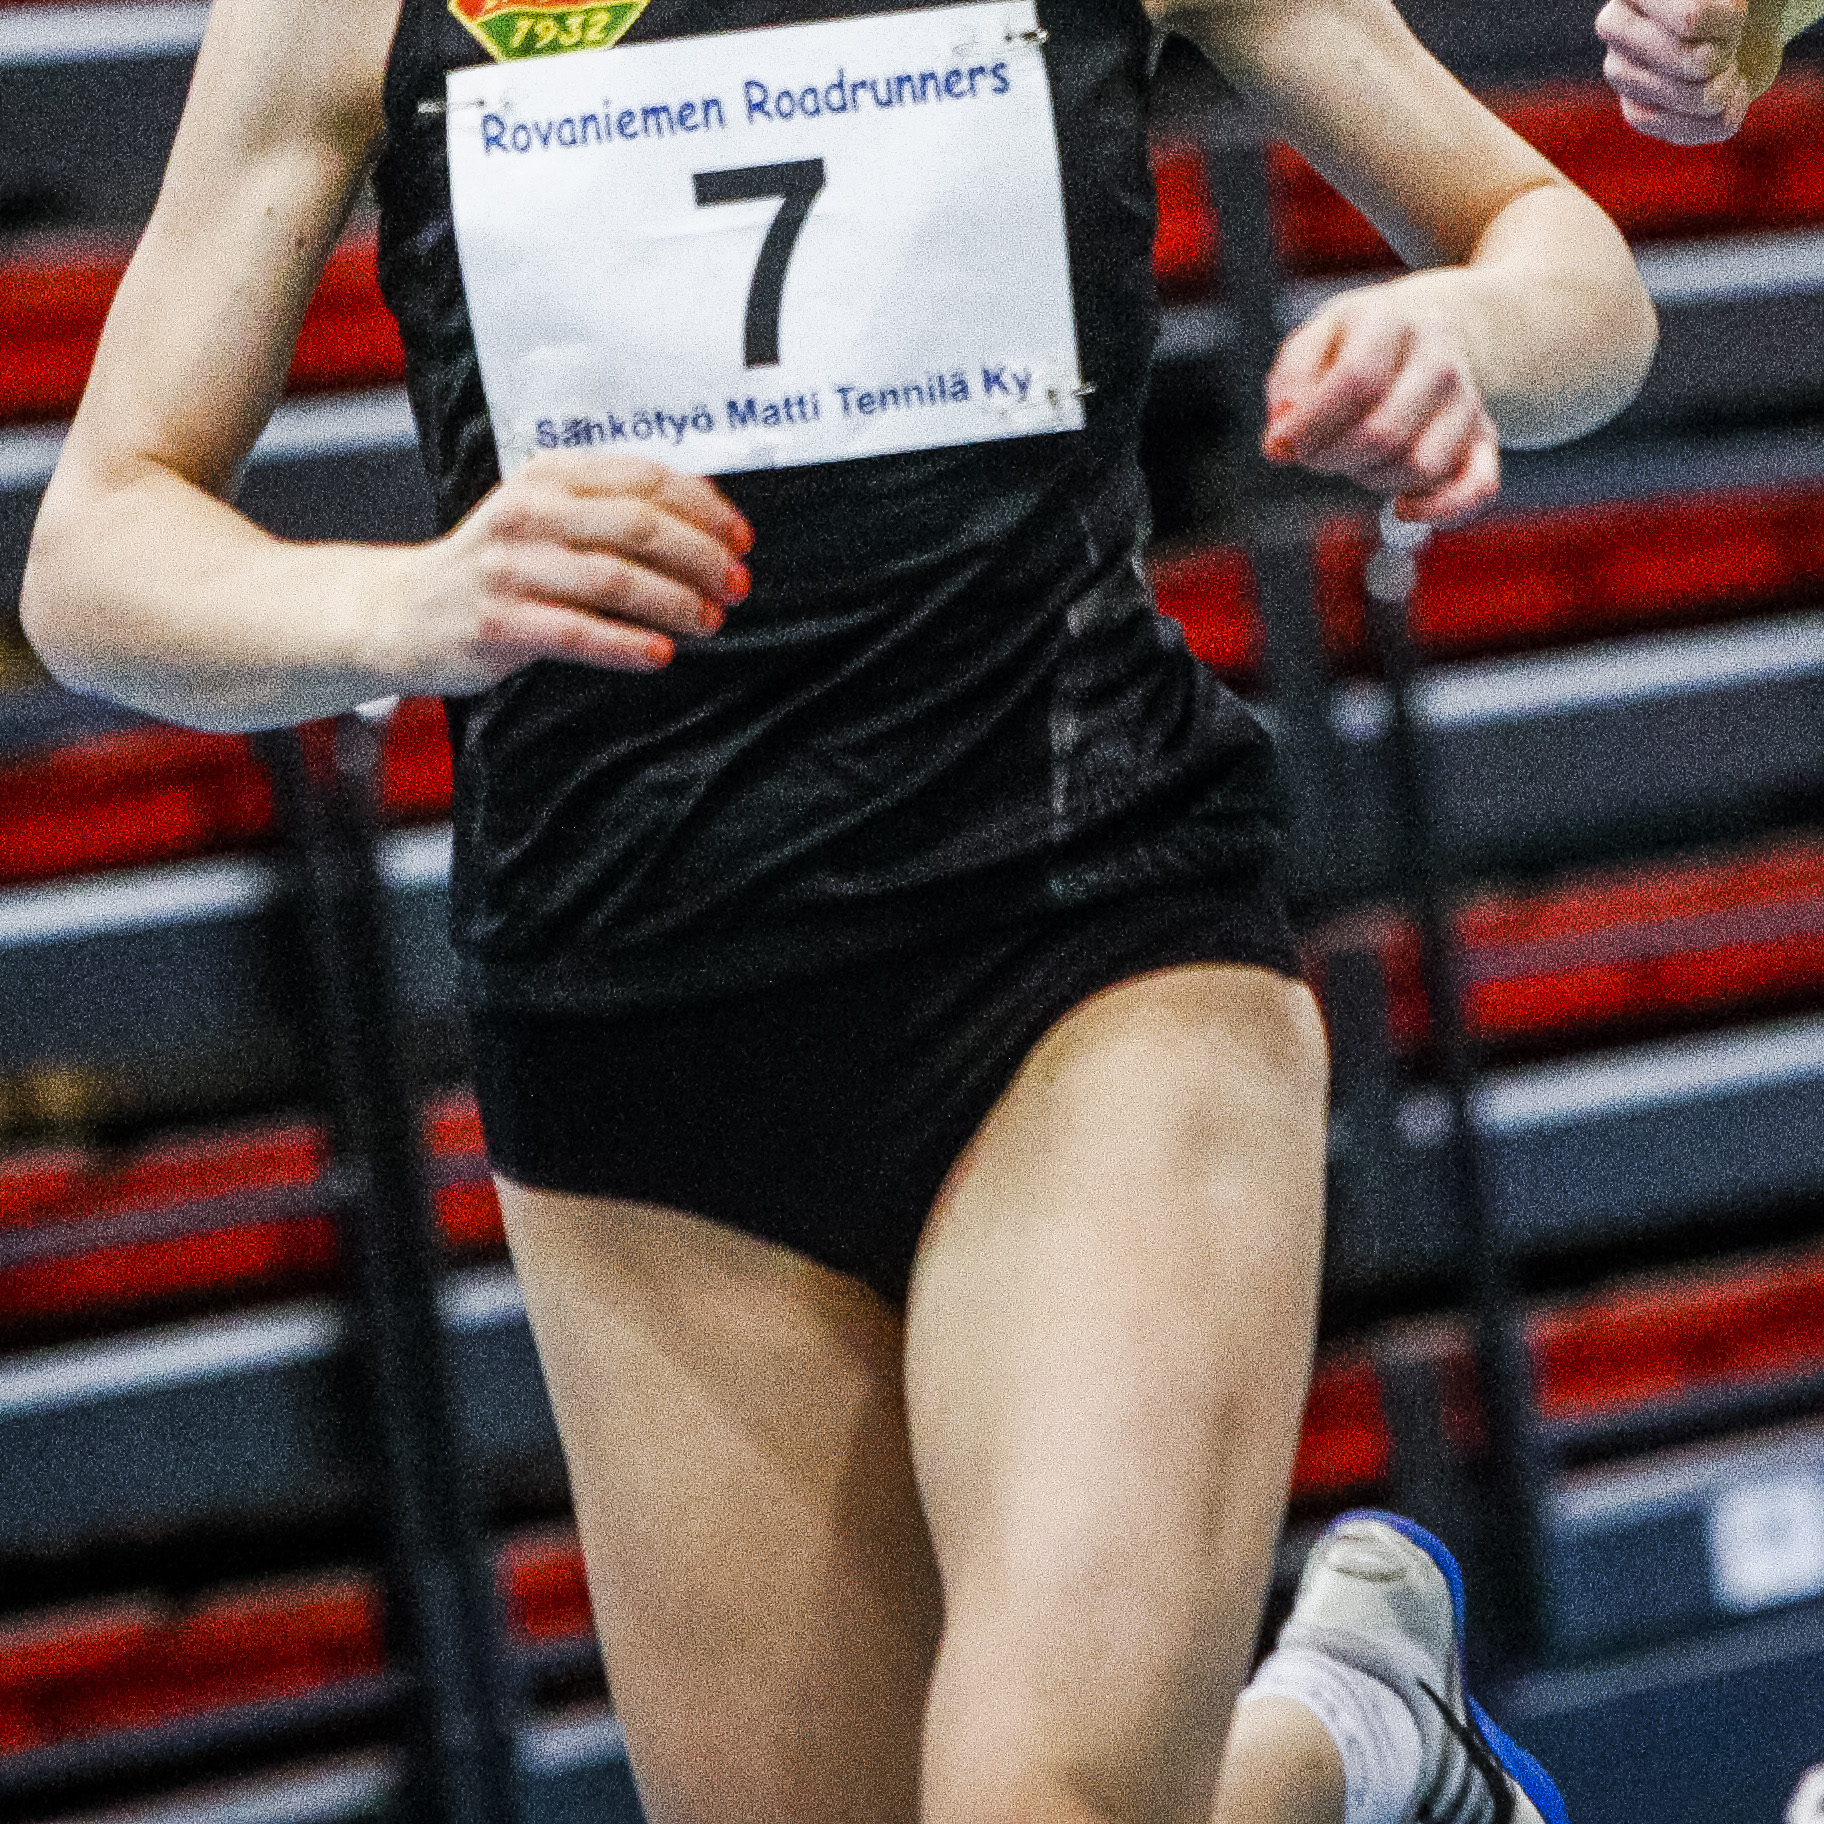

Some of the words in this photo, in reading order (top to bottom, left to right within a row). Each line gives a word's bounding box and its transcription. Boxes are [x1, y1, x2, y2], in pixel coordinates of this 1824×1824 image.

[510, 11, 612, 48] 1932
[482, 97, 726, 156] Rovaniemen
[744, 62, 1011, 124] Roadrunners
[691, 157, 827, 370] 7
[726, 390, 821, 428] Matti
[836, 370, 970, 415] Tennilä
[981, 365, 1032, 404] Ky
